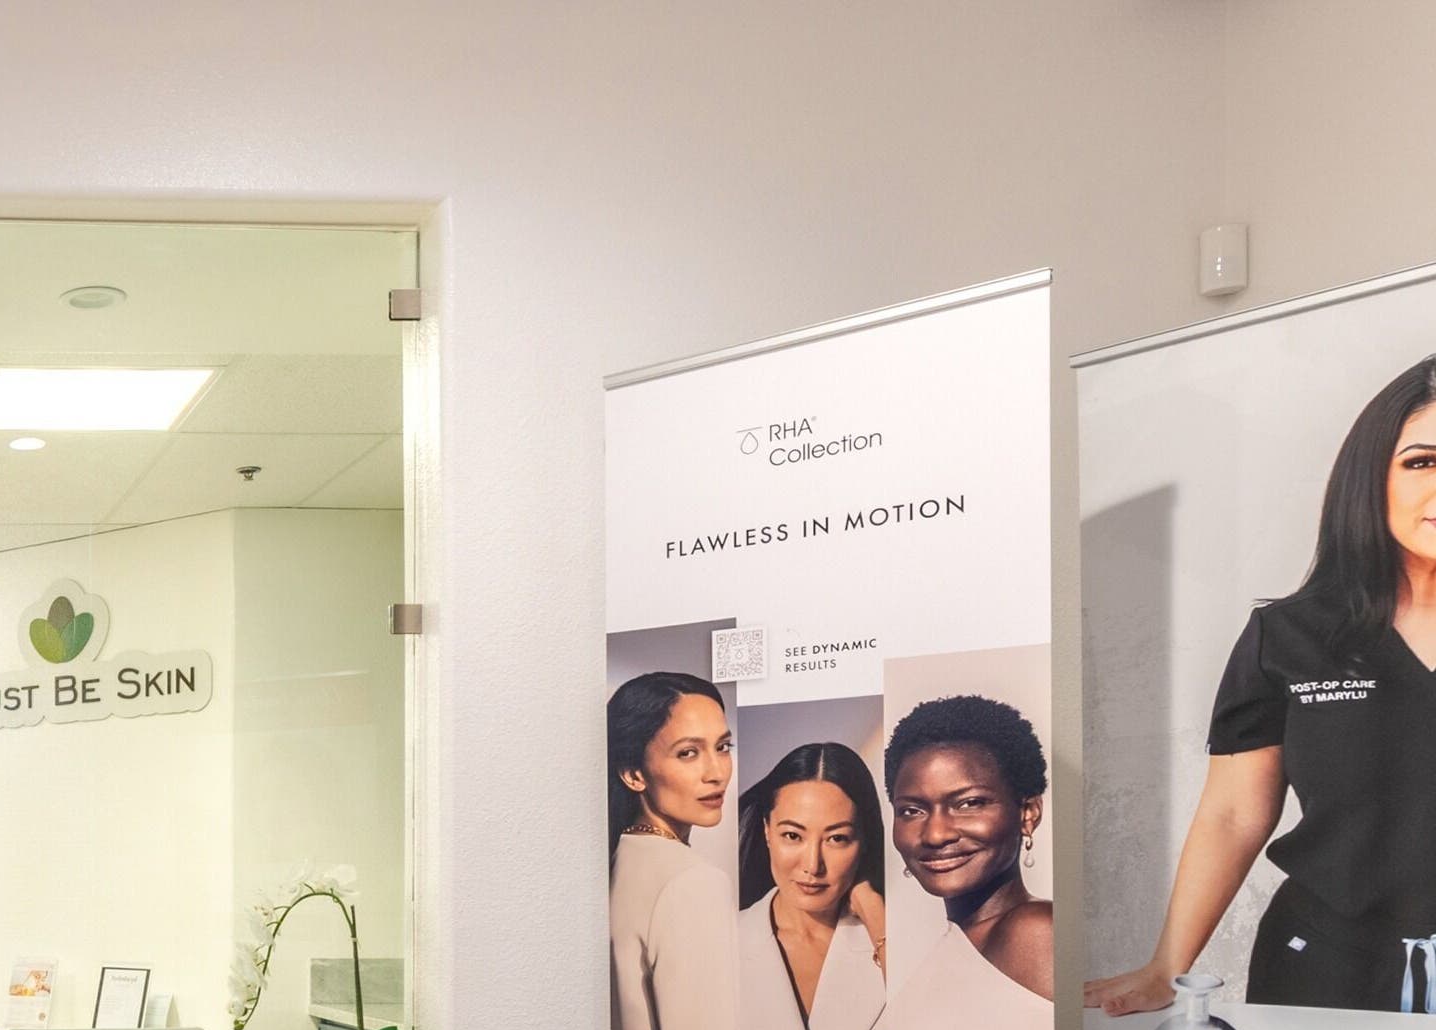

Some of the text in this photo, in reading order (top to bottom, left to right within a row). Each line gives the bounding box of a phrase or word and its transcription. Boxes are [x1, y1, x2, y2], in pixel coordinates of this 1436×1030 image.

[769, 418, 813, 442] RHA
[769, 432, 883, 466] Collection
[666, 494, 966, 559] FLAWLESS IN MOTION
[784, 638, 878, 657] SEE DYNAMIC
[784, 658, 838, 673] RESULTS
[117, 666, 196, 701] SKIN
[1290, 679, 1376, 694] POST-OP CARE
[1300, 690, 1368, 704] BY MARYLU
